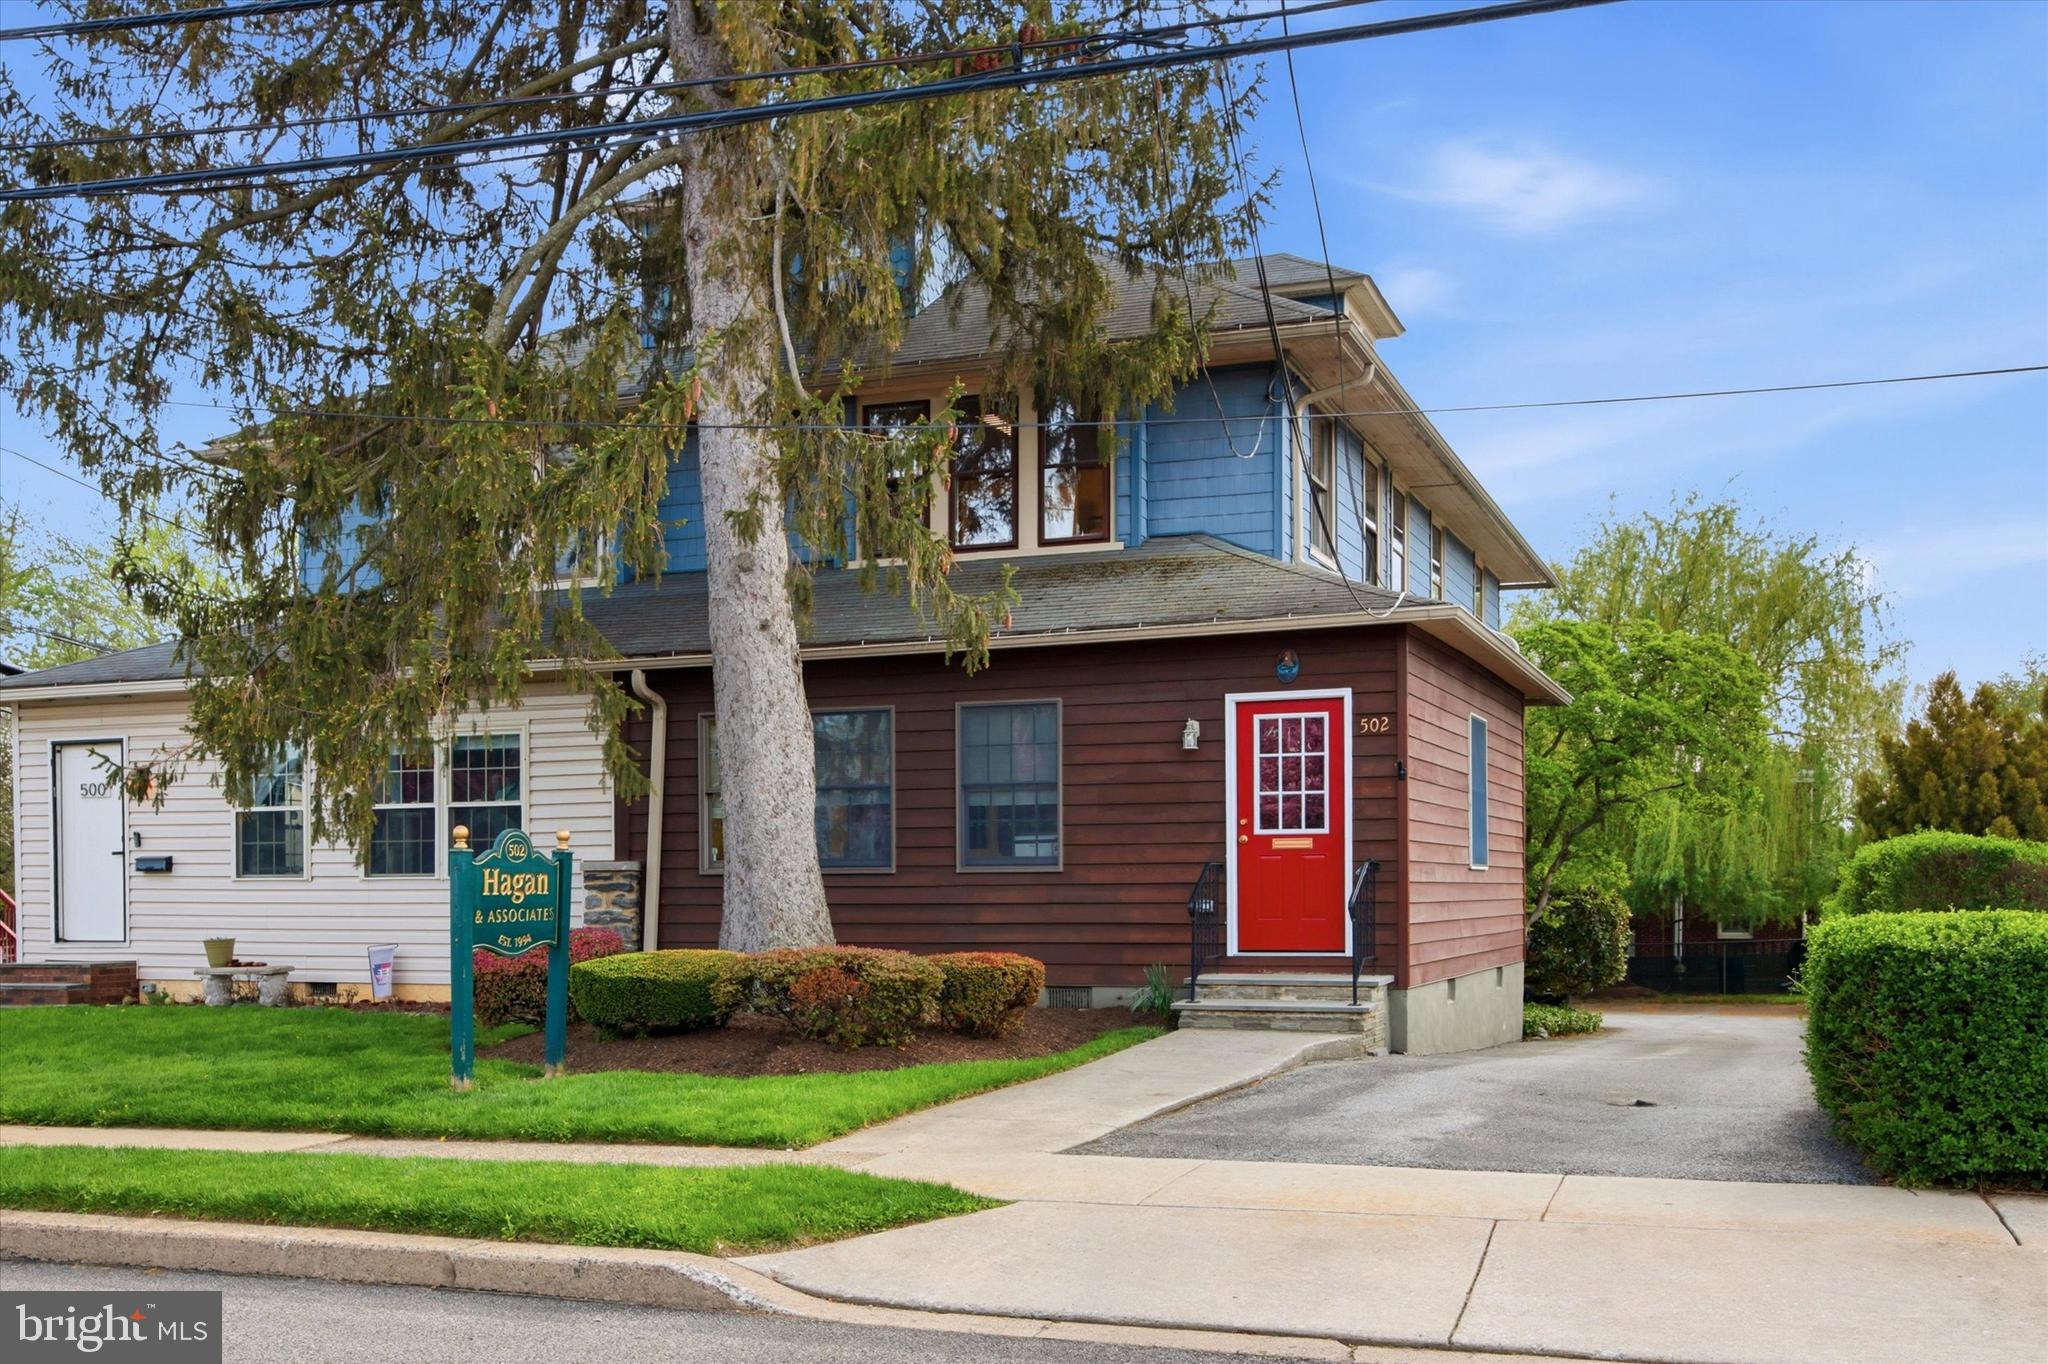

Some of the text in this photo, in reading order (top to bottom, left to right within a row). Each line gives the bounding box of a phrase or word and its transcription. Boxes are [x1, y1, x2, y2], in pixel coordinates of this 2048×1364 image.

[1360, 716, 1389, 734] 502
[80, 783, 106, 796] 500
[508, 844, 525, 857] 502
[482, 868, 549, 904] Hagan
[475, 907, 554, 924] & ASSOCIATES
